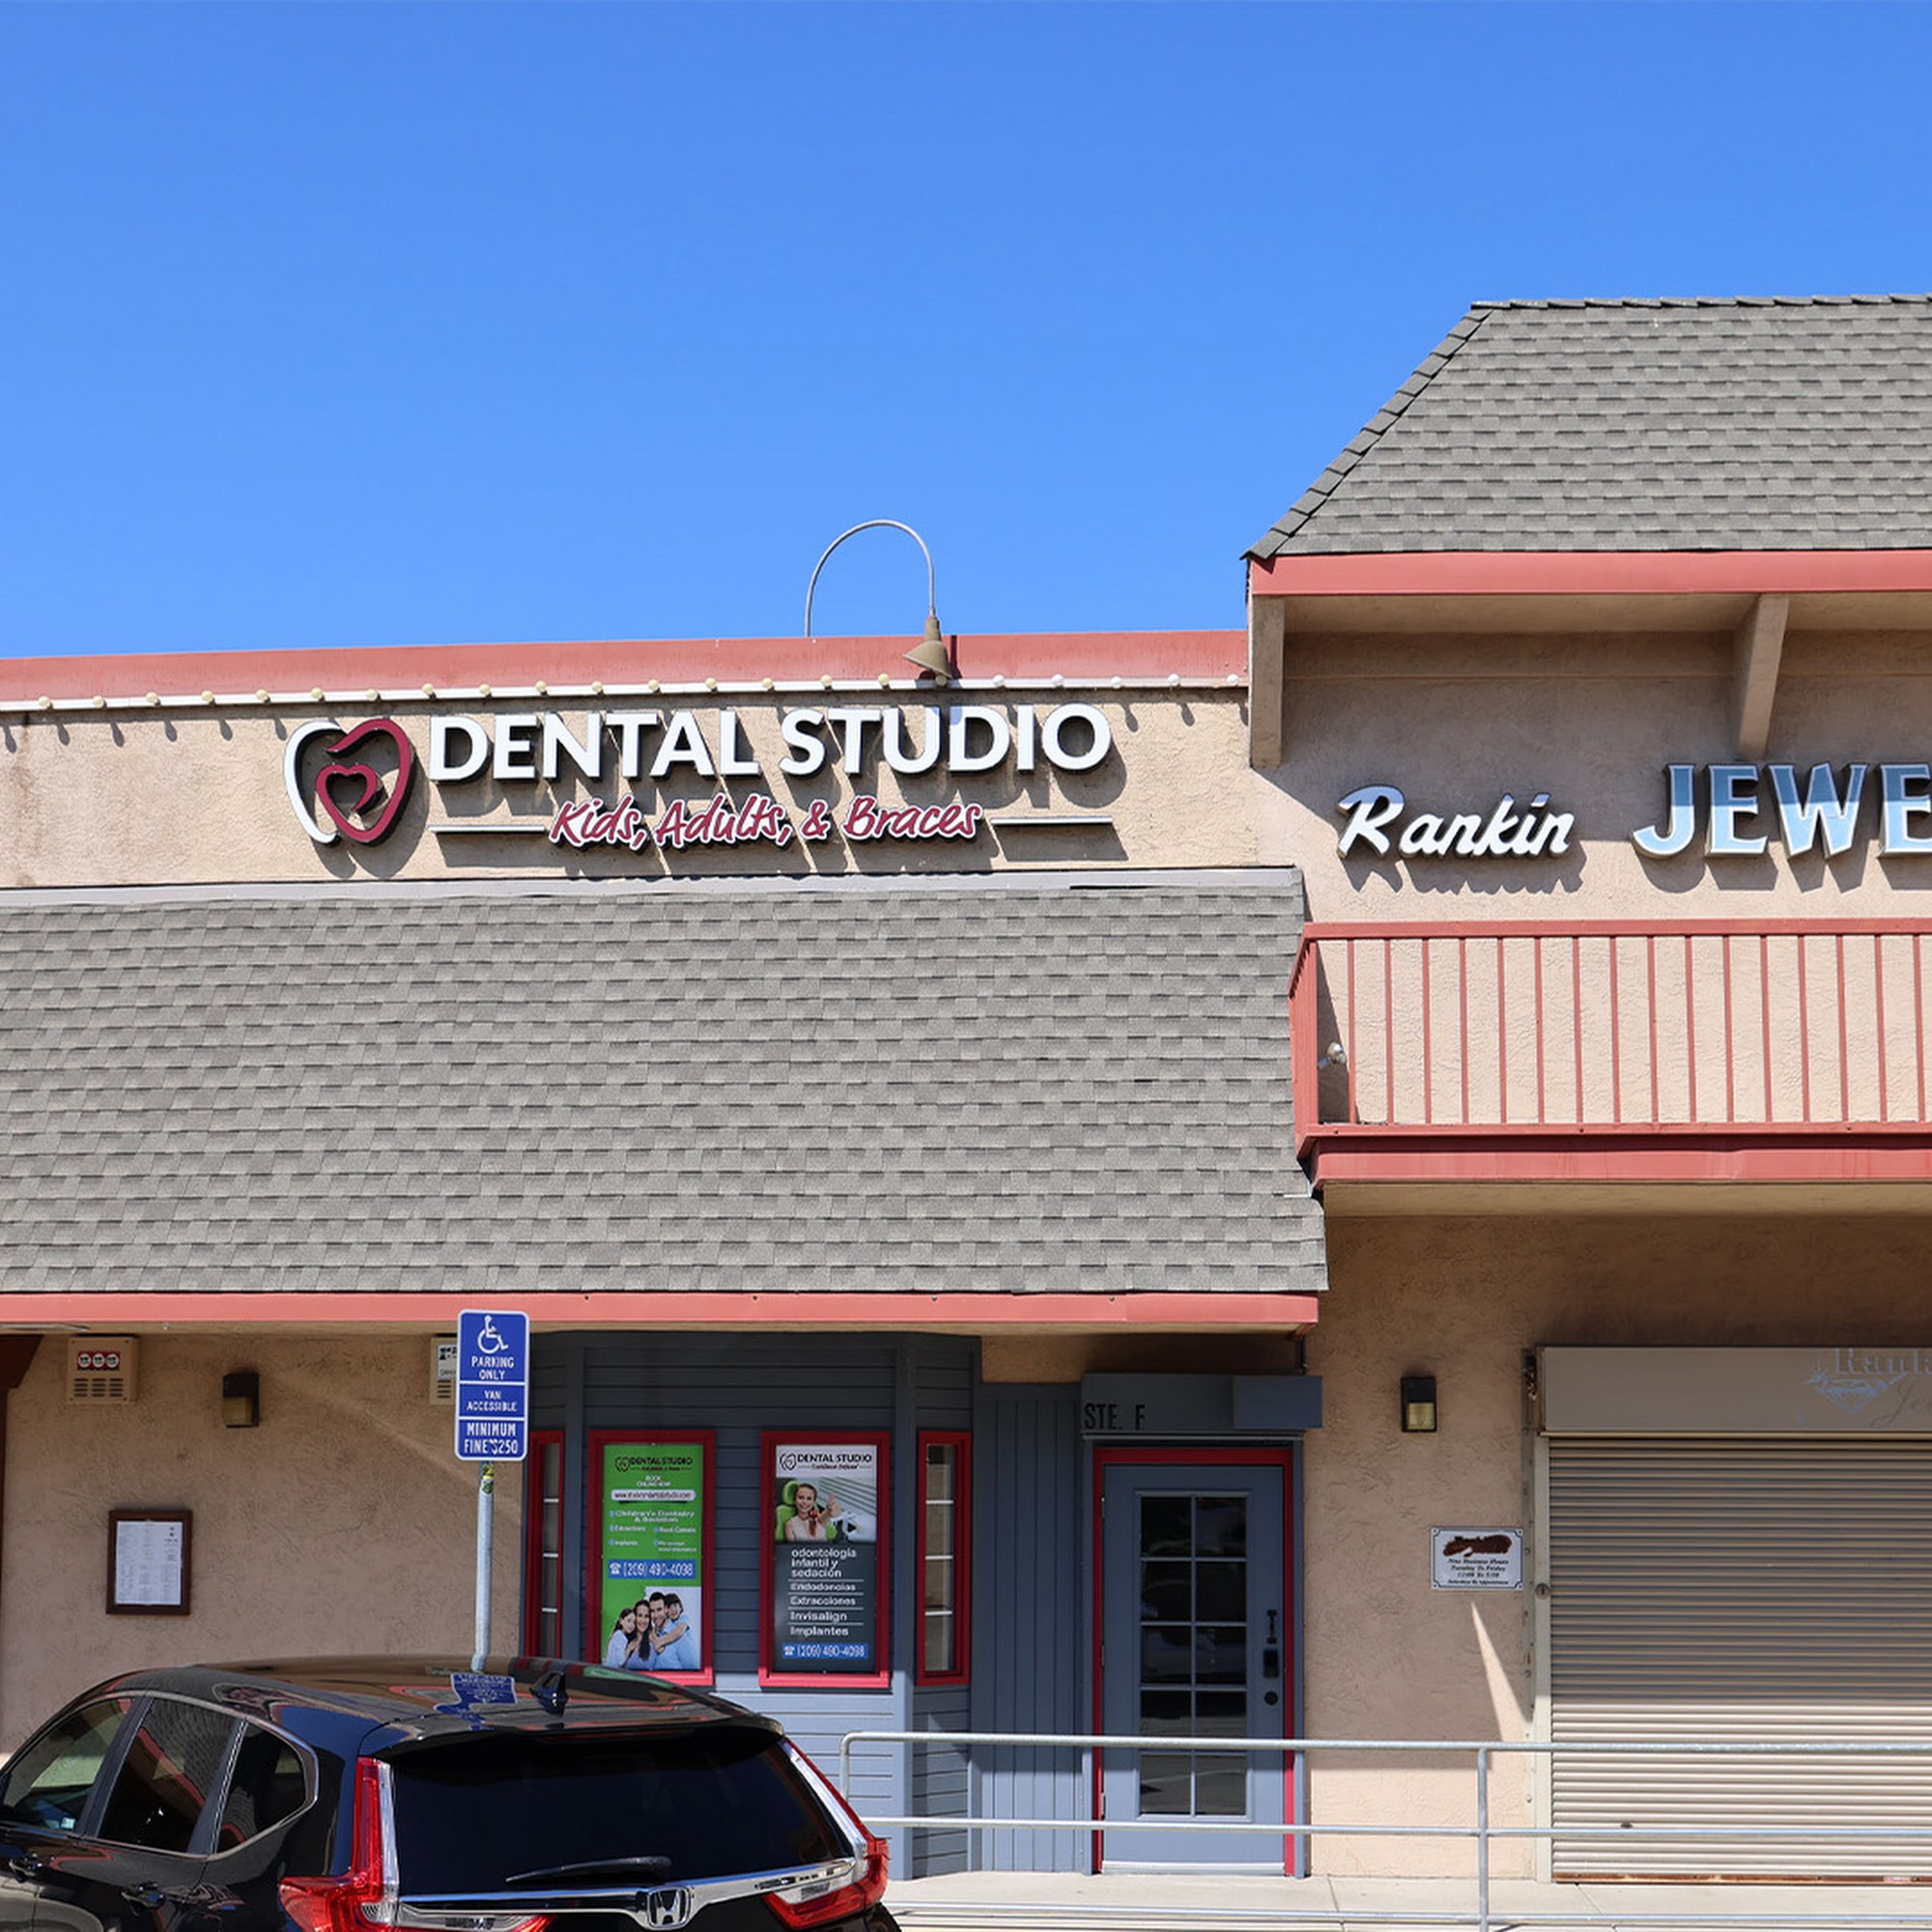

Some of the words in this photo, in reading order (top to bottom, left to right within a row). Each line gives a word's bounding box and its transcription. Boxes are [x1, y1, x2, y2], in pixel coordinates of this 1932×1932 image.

[429, 708, 760, 781] DENTAL
[780, 702, 1112, 776] STUDIO
[1337, 784, 1576, 859] Rankin
[1630, 762, 1932, 860] JEWE
[549, 792, 647, 852] Kids,
[655, 792, 794, 847] Adults,
[801, 798, 829, 840] &
[843, 794, 982, 840] Braces
[471, 1355, 514, 1368] PARKING
[478, 1369, 505, 1380] ONLY
[484, 1390, 501, 1399] VAN
[1084, 1403, 1122, 1430] STE.
[1135, 1404, 1145, 1430] F
[466, 1422, 516, 1436] MINIMUM
[464, 1438, 487, 1453] FINE
[489, 1438, 519, 1454] $250
[798, 1454, 834, 1463] DENTAL
[837, 1454, 872, 1463] STUDIO
[831, 1560, 838, 1569] y
[790, 1596, 856, 1605] Extracciones
[790, 1611, 847, 1623] Invisalign
[790, 1626, 849, 1637] Implantes
